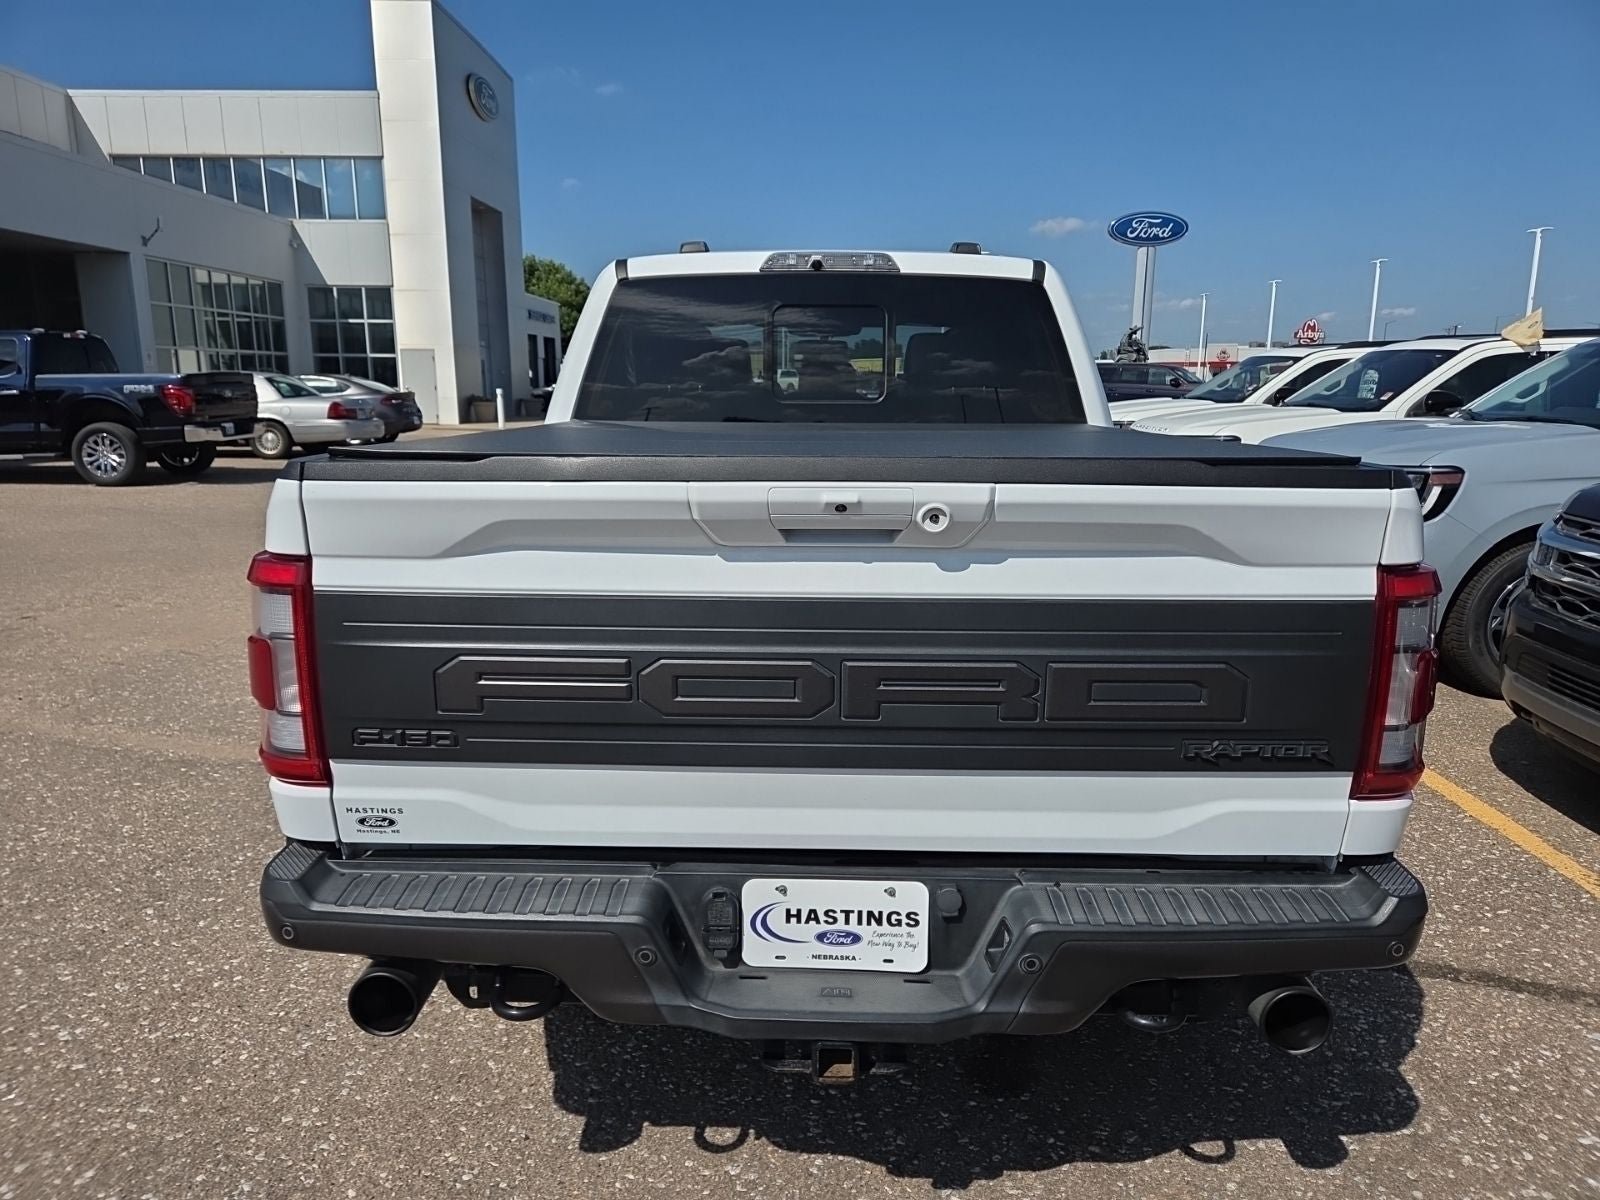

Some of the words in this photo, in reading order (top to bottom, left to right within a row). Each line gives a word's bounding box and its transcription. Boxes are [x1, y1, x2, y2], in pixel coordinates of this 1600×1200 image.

[1127, 218, 1174, 238] Ford
[1297, 329, 1324, 340] Arby's
[435, 654, 1247, 725] FORD
[353, 727, 460, 749] F-150
[1182, 738, 1333, 767] RAPTOR
[364, 818, 389, 826] Ford
[784, 907, 921, 929] HASTINGS
[823, 931, 854, 945] Ford
[871, 930, 904, 939] Experience
[811, 953, 857, 962] NEBRASKA
